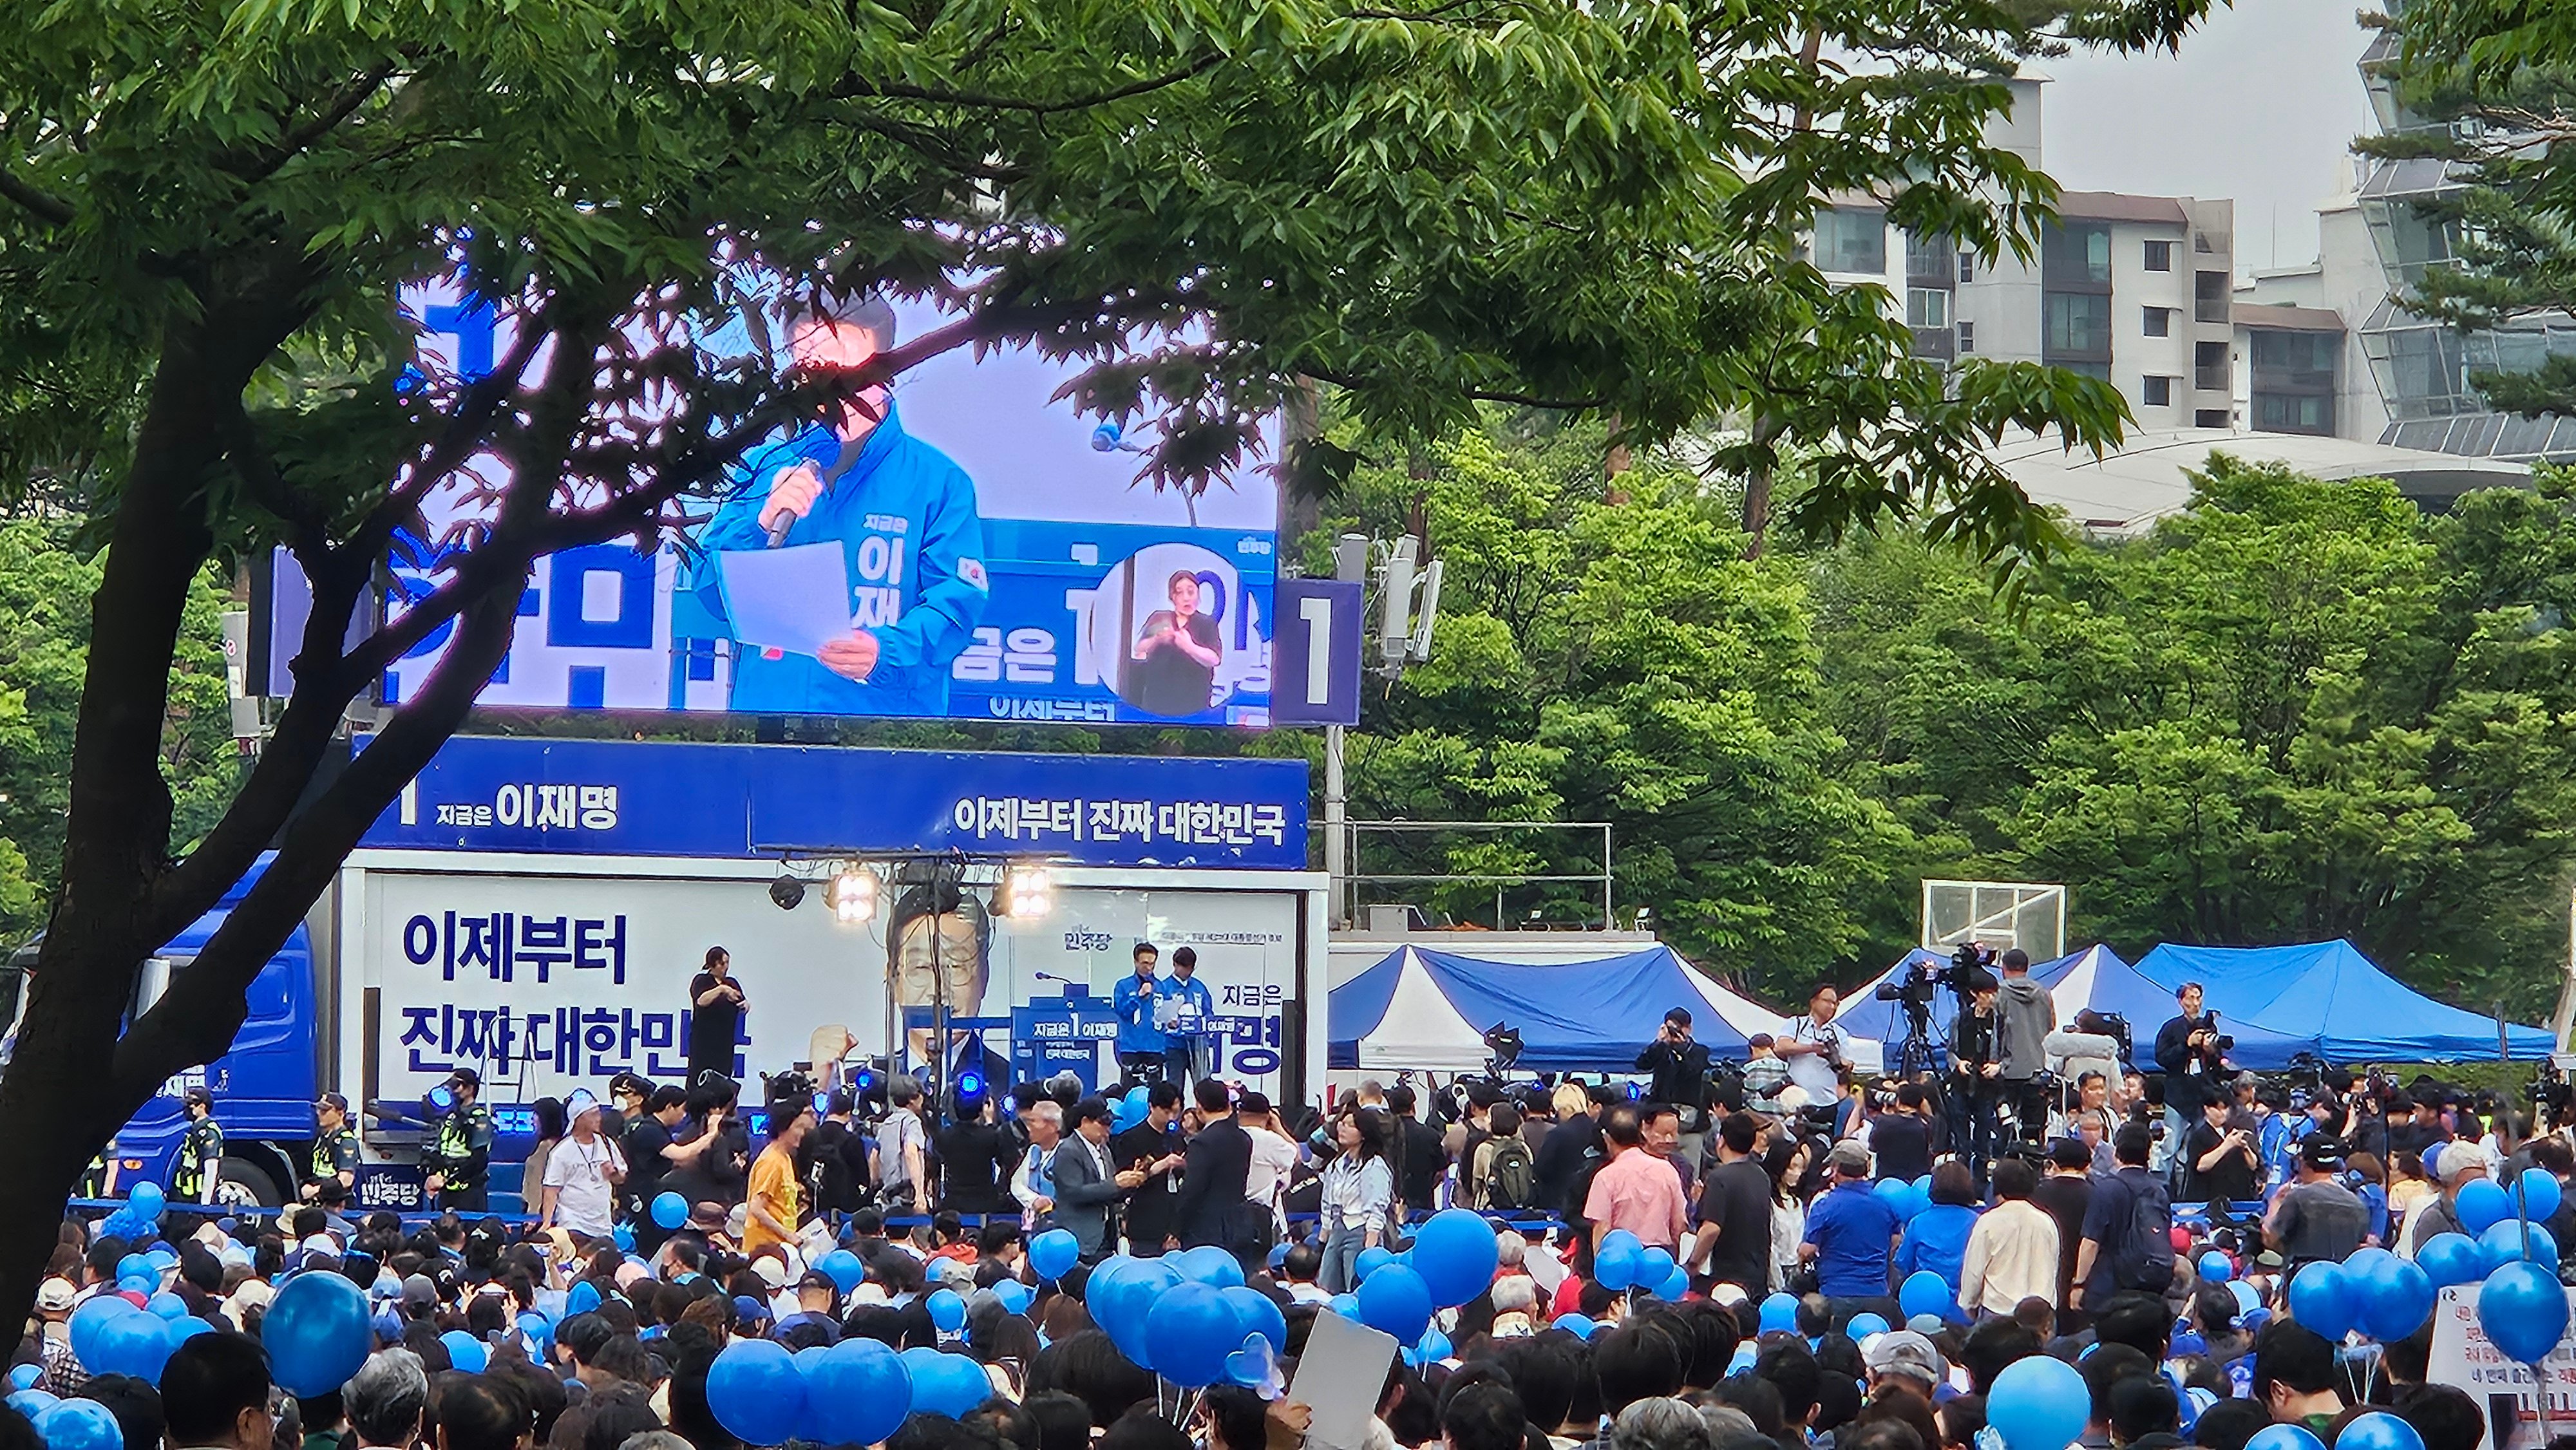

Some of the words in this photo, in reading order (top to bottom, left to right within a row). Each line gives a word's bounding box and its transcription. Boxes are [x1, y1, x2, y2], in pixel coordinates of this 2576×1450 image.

[863, 514, 909, 534] 지금은
[851, 535, 905, 630] 이재
[952, 626, 1058, 684] 금은
[1298, 597, 1331, 705] 1
[436, 804, 493, 827] 지금은
[496, 783, 618, 829] 이재명
[954, 795, 1083, 840] 이제부터
[1087, 801, 1153, 842] 진짜
[1158, 802, 1286, 846] 대한민국
[402, 910, 627, 984] 이제부터
[1222, 984, 1283, 1006] 지금은
[399, 1003, 510, 1076] 진짜
[1033, 1022, 1070, 1037] 지금은
[1070, 1012, 1079, 1037] 1
